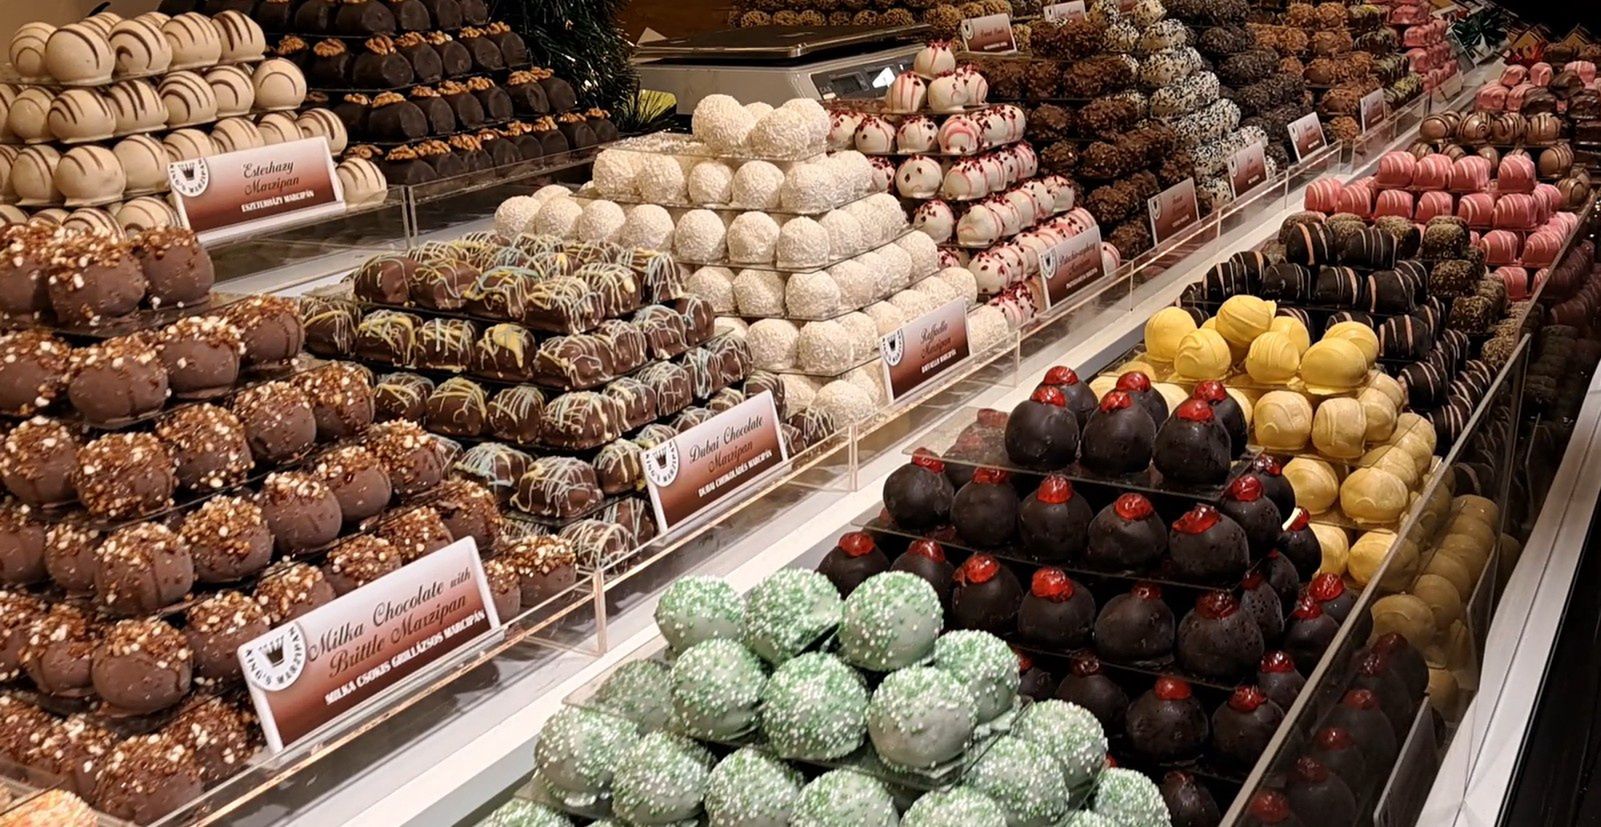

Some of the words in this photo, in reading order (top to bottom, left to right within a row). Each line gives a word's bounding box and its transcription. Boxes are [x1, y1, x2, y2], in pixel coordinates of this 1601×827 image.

[242, 160, 295, 179] Esterhazy
[244, 176, 300, 196] Marzipan
[689, 436, 720, 464] Dubai
[723, 415, 764, 445] Chocolate
[708, 440, 753, 473] Marzipan
[307, 621, 365, 662] Milka
[372, 580, 444, 628] Chocolate
[449, 567, 471, 589] with
[329, 633, 386, 678] Brittle
[390, 595, 466, 645] Marzipan
[324, 680, 357, 706] MILKA
[356, 661, 392, 688] CSOKIS
[443, 608, 486, 640] MARCIPÁN
